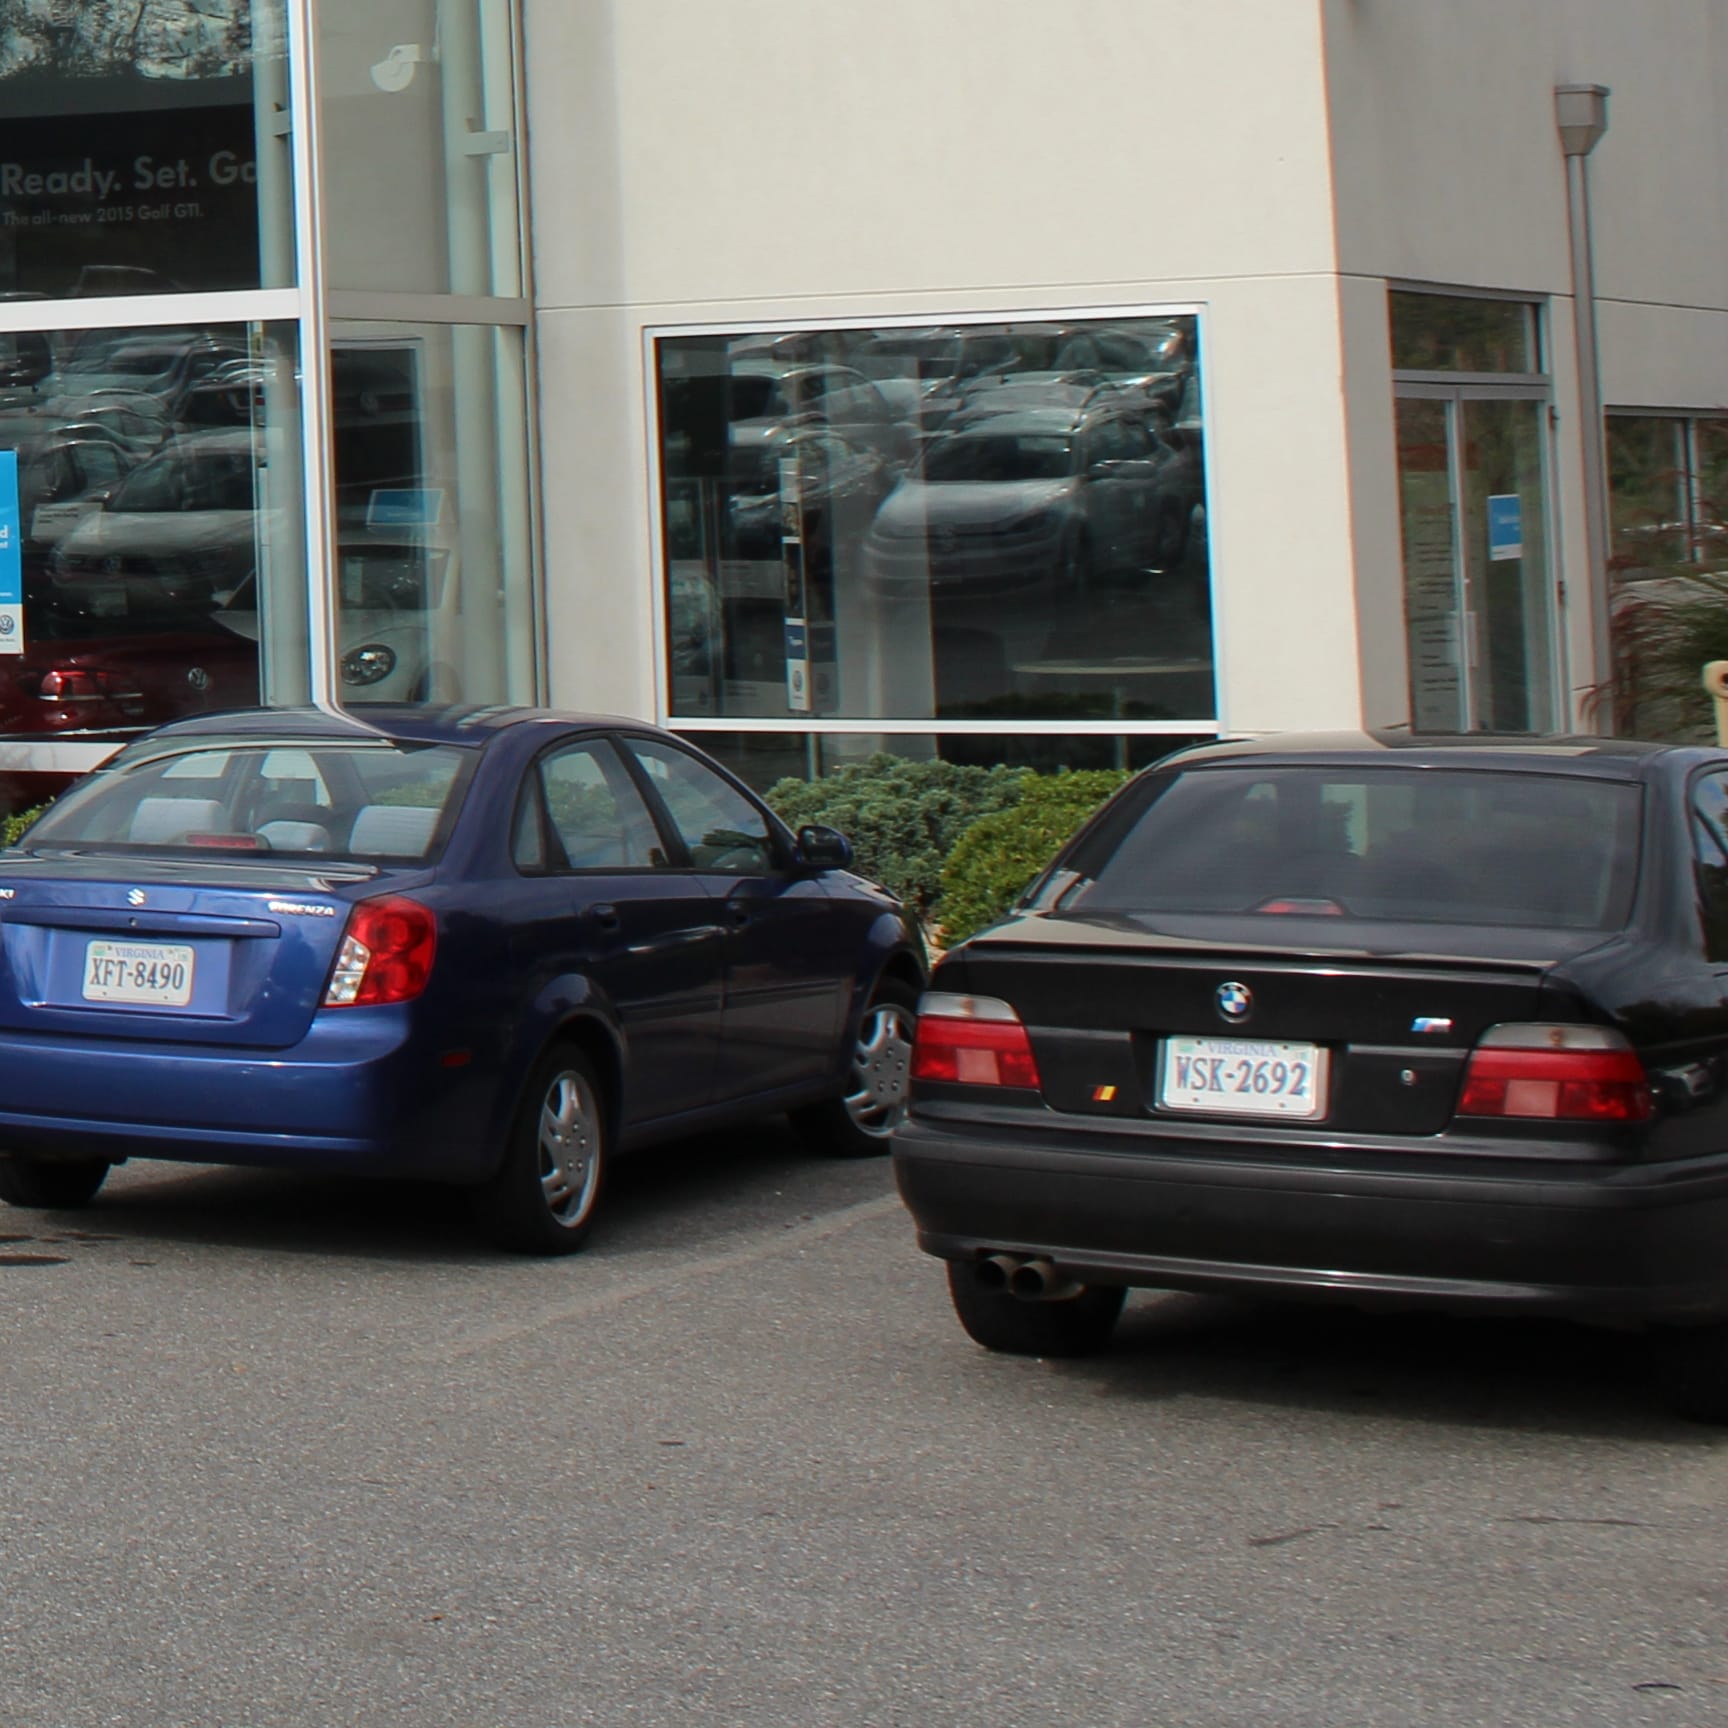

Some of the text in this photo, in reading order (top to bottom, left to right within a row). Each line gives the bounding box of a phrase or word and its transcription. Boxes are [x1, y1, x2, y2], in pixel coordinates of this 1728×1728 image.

[0, 157, 122, 200] Ready.
[134, 155, 197, 190] Set.
[2, 210, 28, 226] The
[32, 208, 92, 226] all-new
[96, 207, 133, 222] 2015
[138, 203, 170, 221] Golf
[114, 946, 165, 961] VIRGINIA
[88, 956, 185, 991] XFT-8490
[1207, 1040, 1277, 1058] VIRGINIA
[1175, 1054, 1309, 1096] WSK-2692
